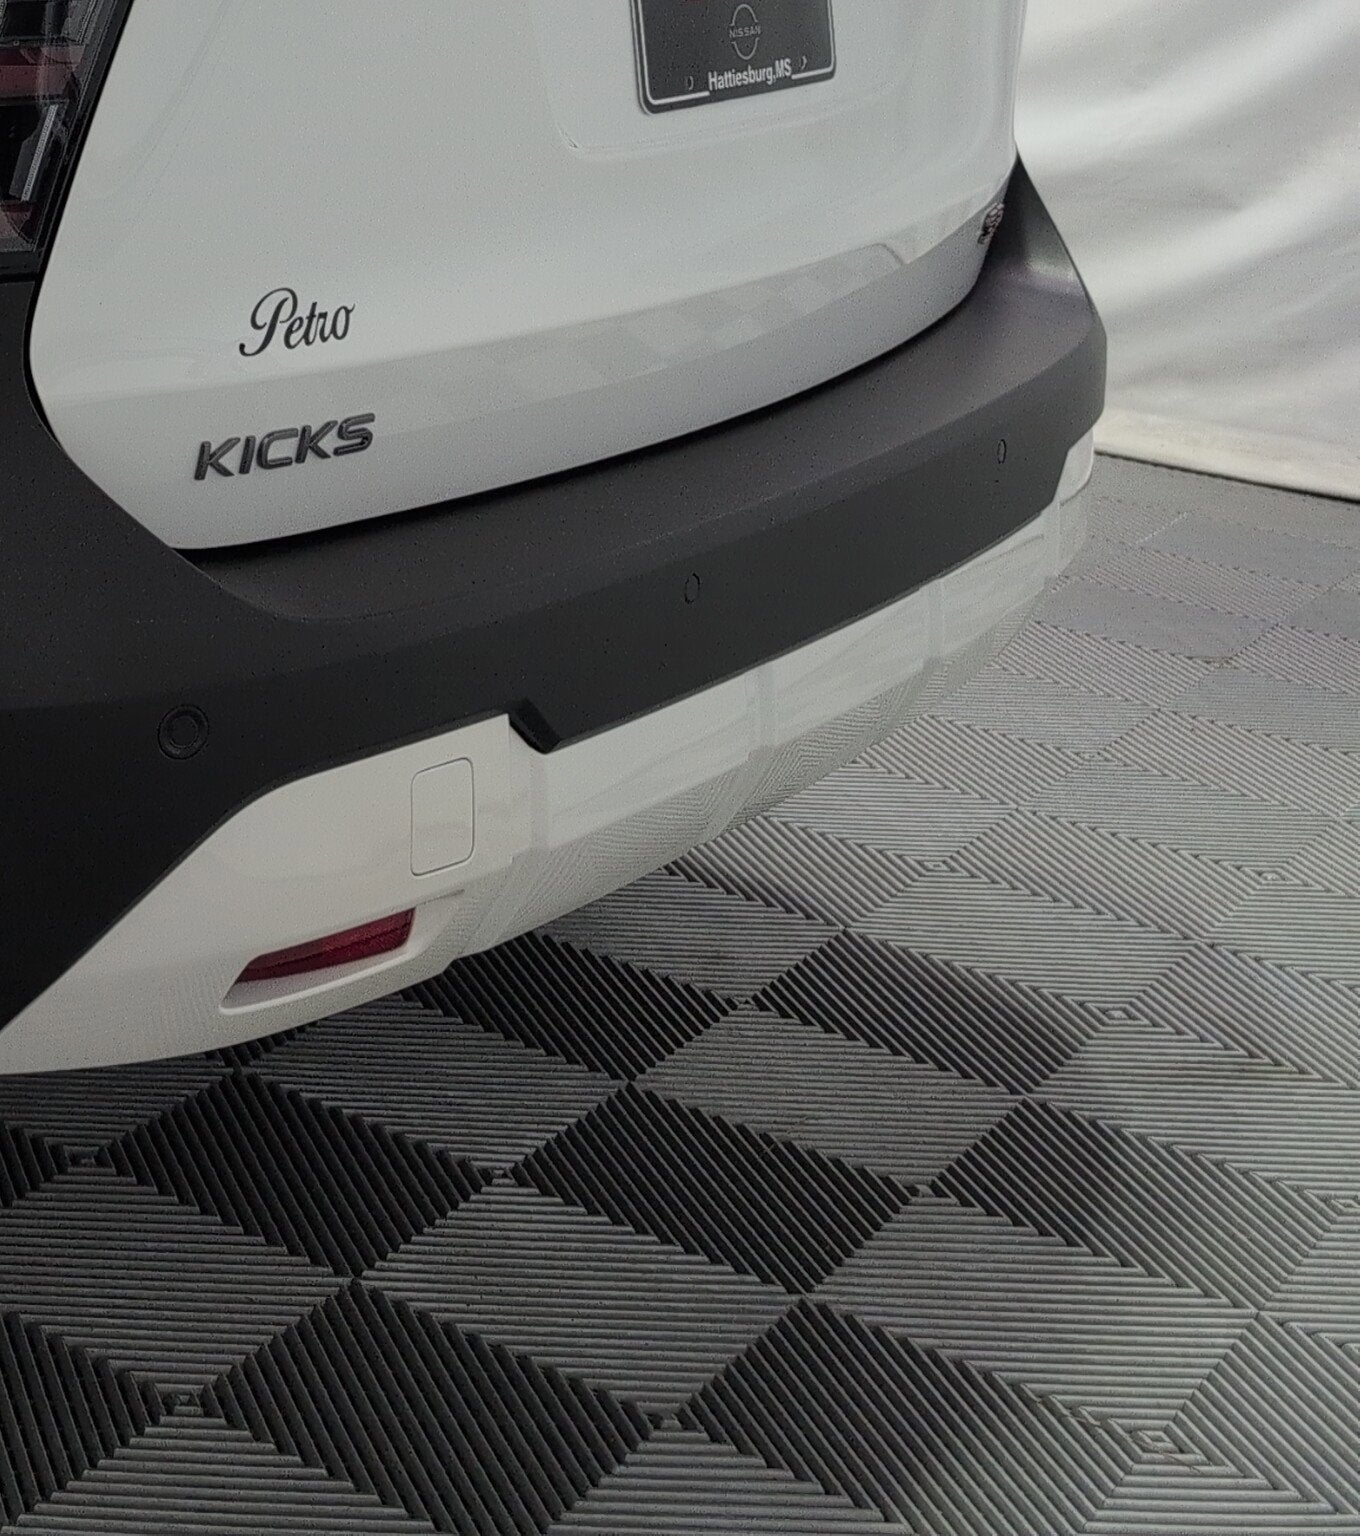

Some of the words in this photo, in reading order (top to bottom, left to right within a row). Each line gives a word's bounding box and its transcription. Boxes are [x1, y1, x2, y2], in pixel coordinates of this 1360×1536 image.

[729, 25, 761, 39] NISSAN
[238, 286, 356, 357] Petro
[193, 412, 376, 481] KICKS
